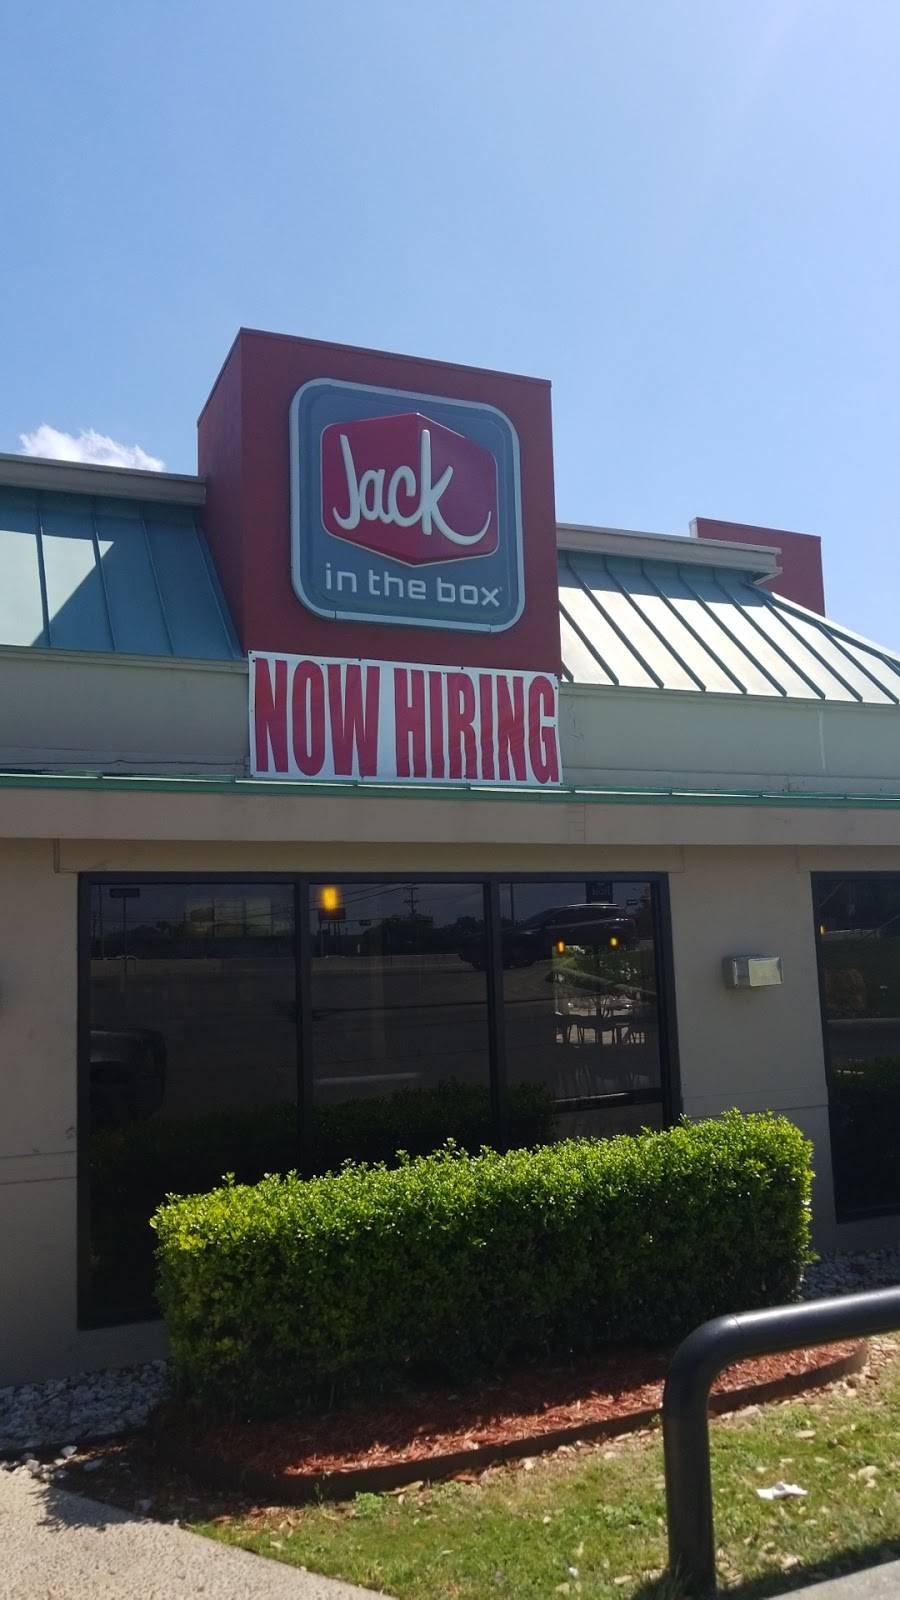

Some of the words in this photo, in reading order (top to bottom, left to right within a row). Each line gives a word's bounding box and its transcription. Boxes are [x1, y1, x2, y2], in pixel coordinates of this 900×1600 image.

[333, 429, 492, 546] Jack
[325, 563, 358, 593] in
[369, 569, 427, 600] the
[437, 577, 500, 607] box
[255, 658, 380, 777] NOW
[394, 668, 560, 784] HIRING
